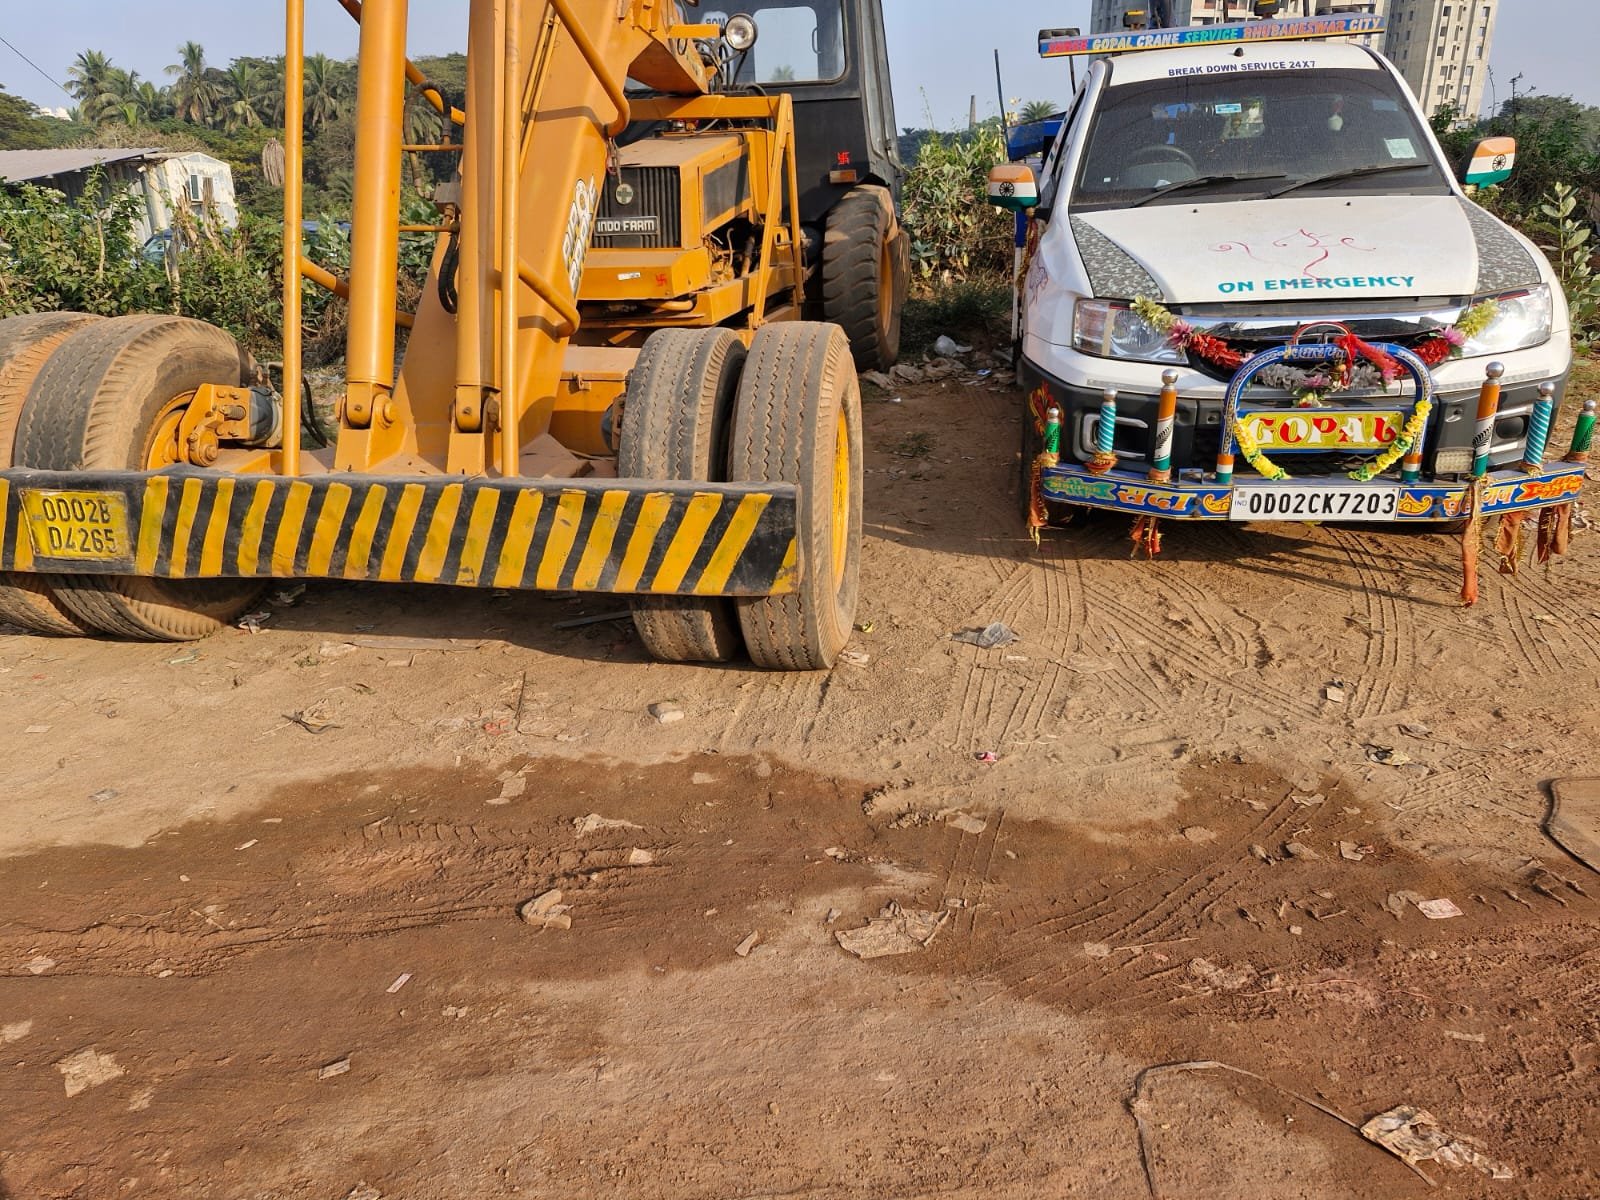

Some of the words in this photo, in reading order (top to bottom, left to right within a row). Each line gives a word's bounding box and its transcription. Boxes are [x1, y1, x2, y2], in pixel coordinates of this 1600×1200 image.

[1092, 37, 1133, 50] GOPAL
[1136, 33, 1180, 47] CRANE
[1184, 28, 1238, 44] SERVICE
[1243, 20, 1346, 38] BHUBANESWAR
[1350, 17, 1381, 31] CITY
[1168, 66, 1203, 77] BREAK
[1206, 64, 1238, 73] DOWN
[1241, 61, 1286, 71] SERVICE
[1289, 60, 1316, 69] 24X7
[597, 220, 620, 232] INDO
[622, 219, 655, 232] FARM
[1217, 281, 1254, 294] ON
[1264, 276, 1415, 290] EMERGENCY
[1249, 417, 1398, 443] GOPAL
[1250, 493, 1395, 514] OD02CK7203
[48, 527, 117, 553] D4265
